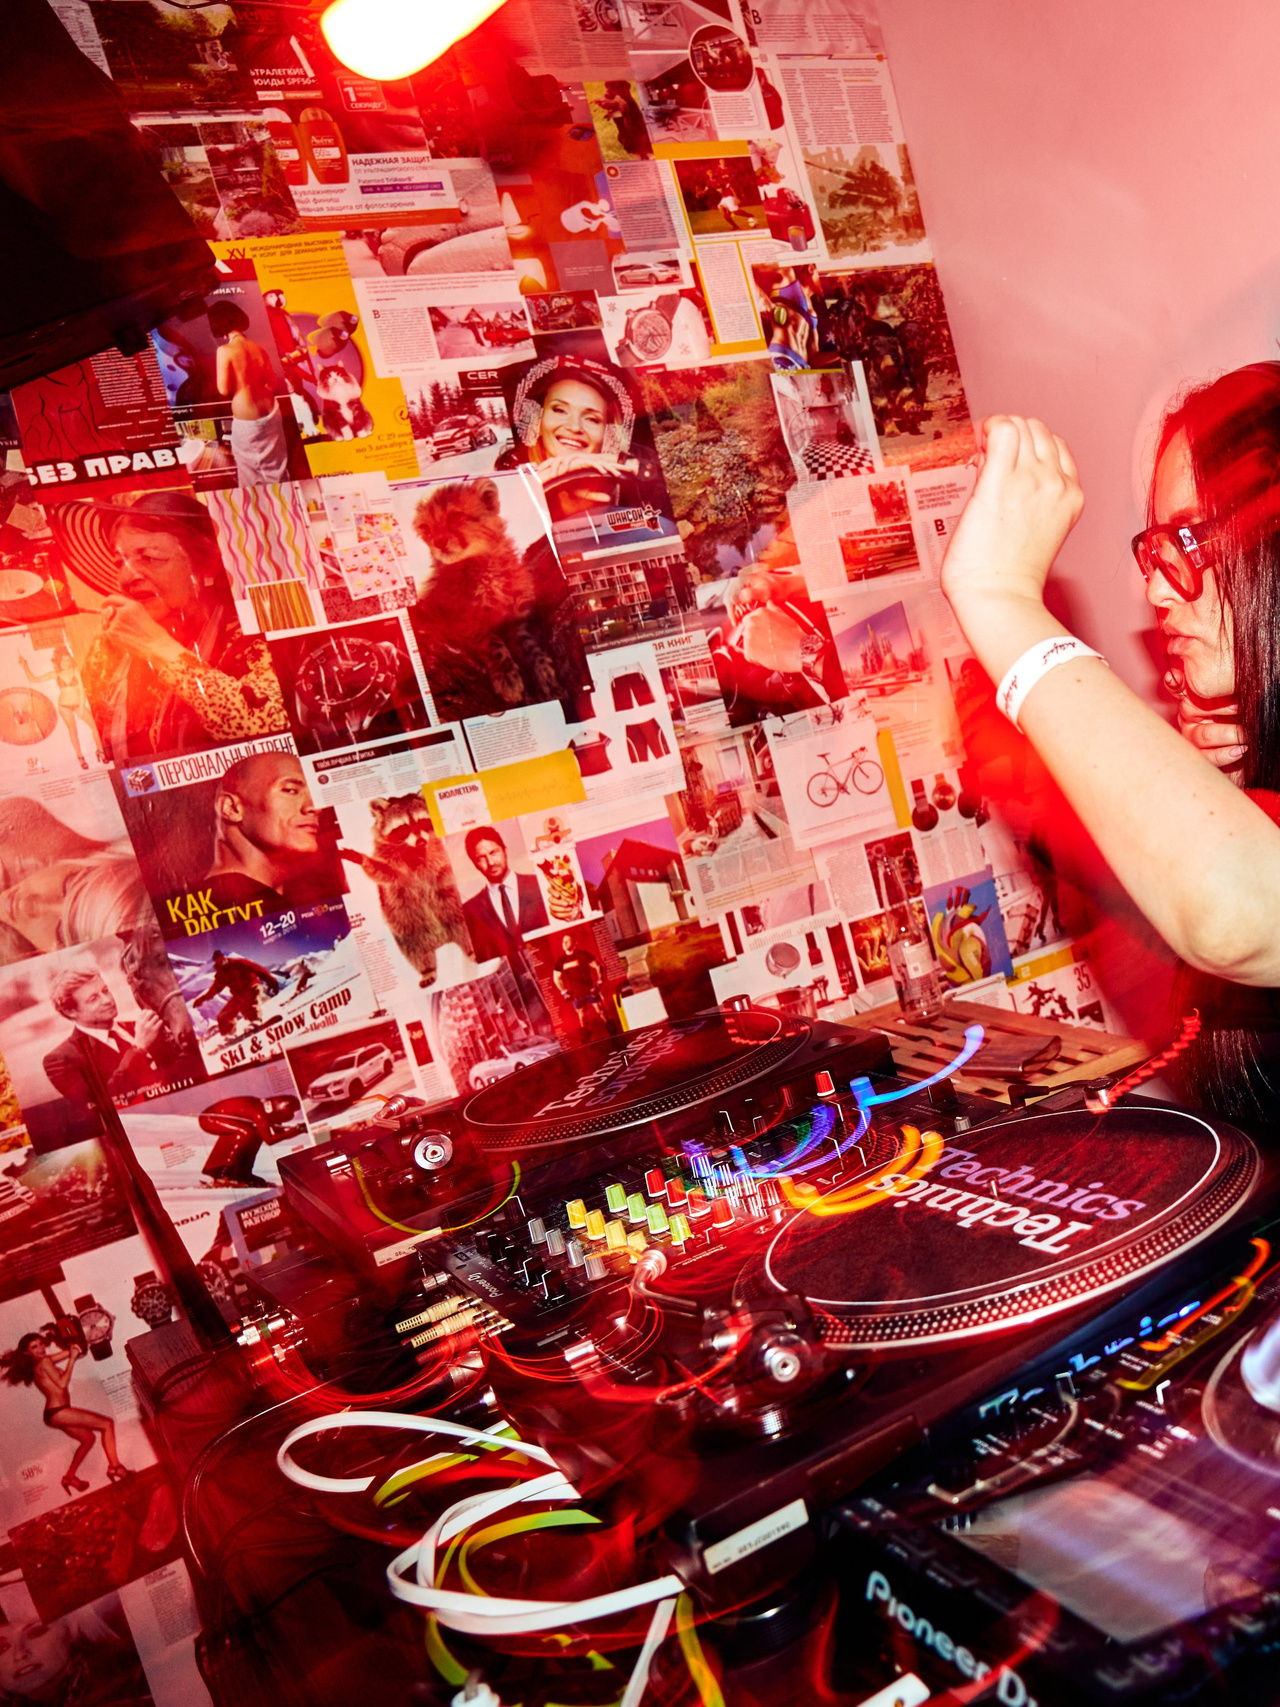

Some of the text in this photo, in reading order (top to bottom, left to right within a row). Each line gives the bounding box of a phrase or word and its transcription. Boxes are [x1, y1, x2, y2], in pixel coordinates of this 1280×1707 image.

[344, 86, 356, 102] 1
[352, 155, 431, 167] НАДЕЖНАЯ ЗАЩИТ
[227, 247, 246, 260] XV
[606, 508, 644, 526] ШАНСОН
[668, 635, 693, 649] КНИГ
[166, 888, 219, 924] КАК
[1073, 963, 1092, 992] 35
[219, 986, 353, 1071] Ski & Snow Camp
[534, 1028, 667, 1118] Technics
[928, 1145, 1147, 1222] Technics
[866, 1173, 1093, 1255] Technics
[866, 1570, 991, 1683] Pioneer
